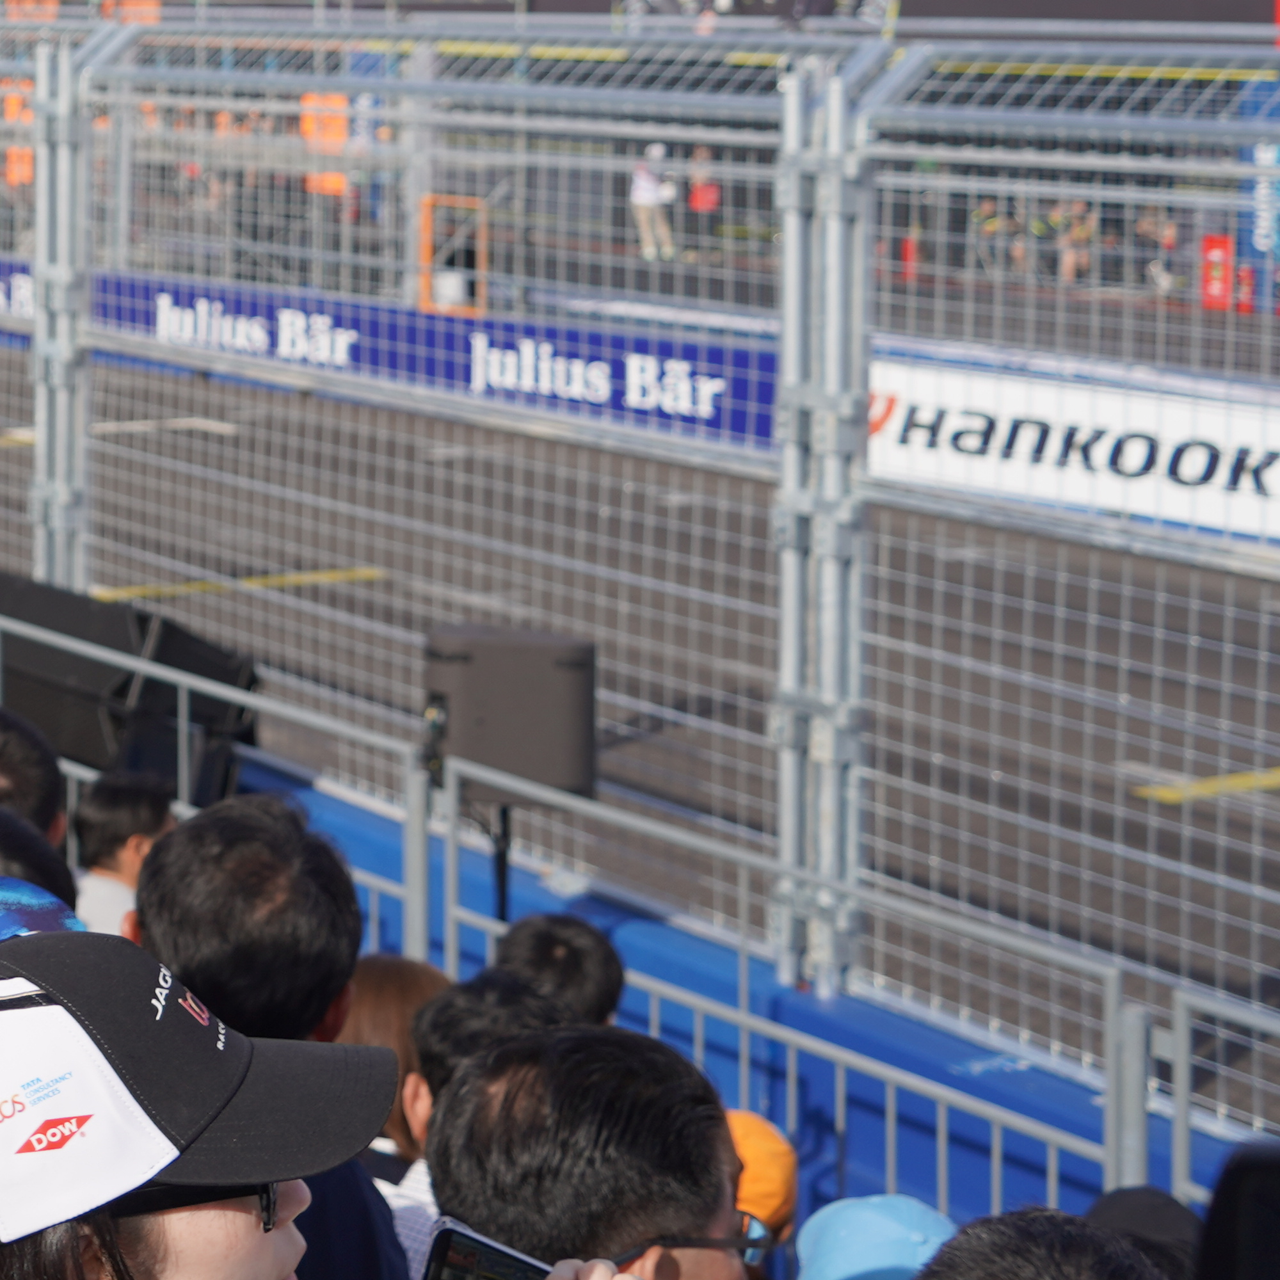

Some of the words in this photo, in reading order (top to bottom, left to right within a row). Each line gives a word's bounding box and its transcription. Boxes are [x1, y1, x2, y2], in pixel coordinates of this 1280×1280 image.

[154, 291, 271, 356] Julius
[276, 307, 359, 367] Bär
[469, 331, 611, 406] Julius
[622, 351, 727, 419] Bär
[20, 1077, 42, 1091] TATA
